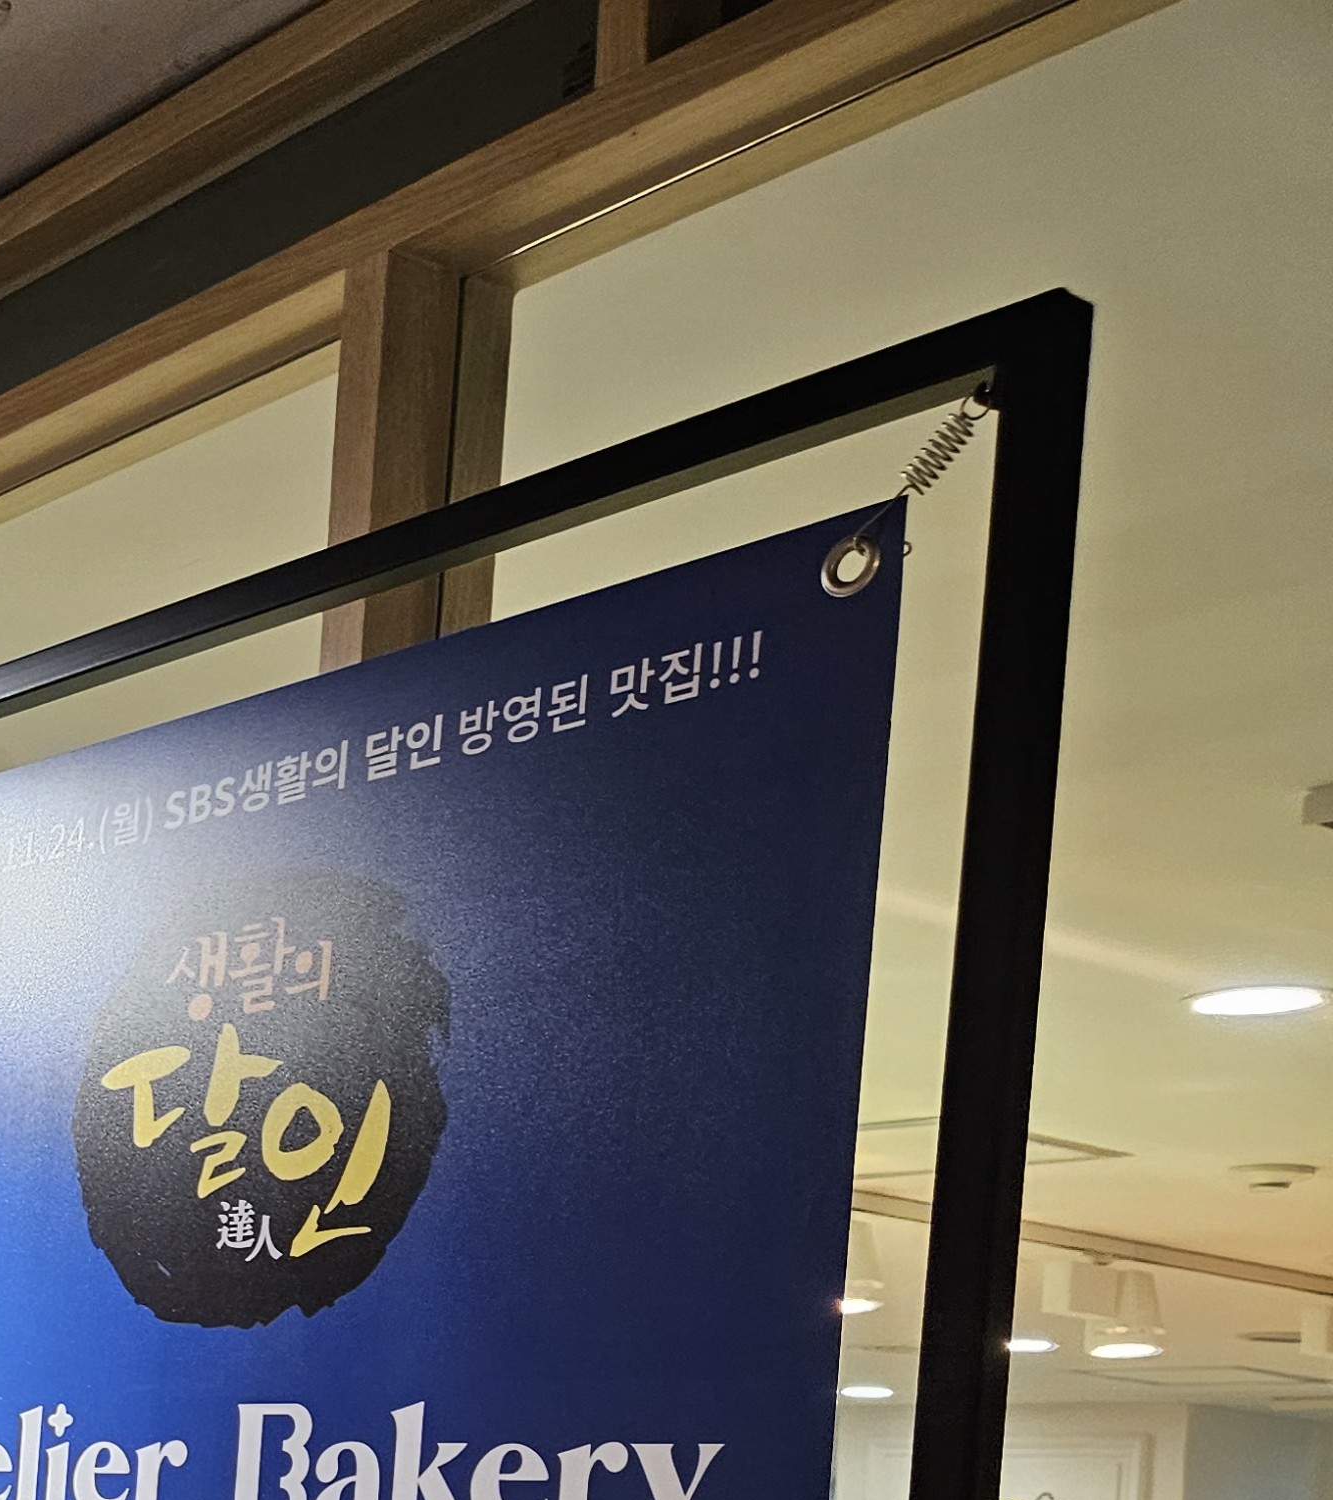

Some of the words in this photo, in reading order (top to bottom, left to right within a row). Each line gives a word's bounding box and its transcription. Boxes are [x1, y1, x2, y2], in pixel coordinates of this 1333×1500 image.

[164, 740, 348, 829] SBS생활의
[365, 714, 443, 781] 달인
[459, 674, 589, 756] 방영된
[610, 631, 764, 718] 맛집!!!
[166, 917, 332, 1021] 생활의
[101, 1023, 391, 1257] 달인
[216, 1200, 283, 1262] 達人
